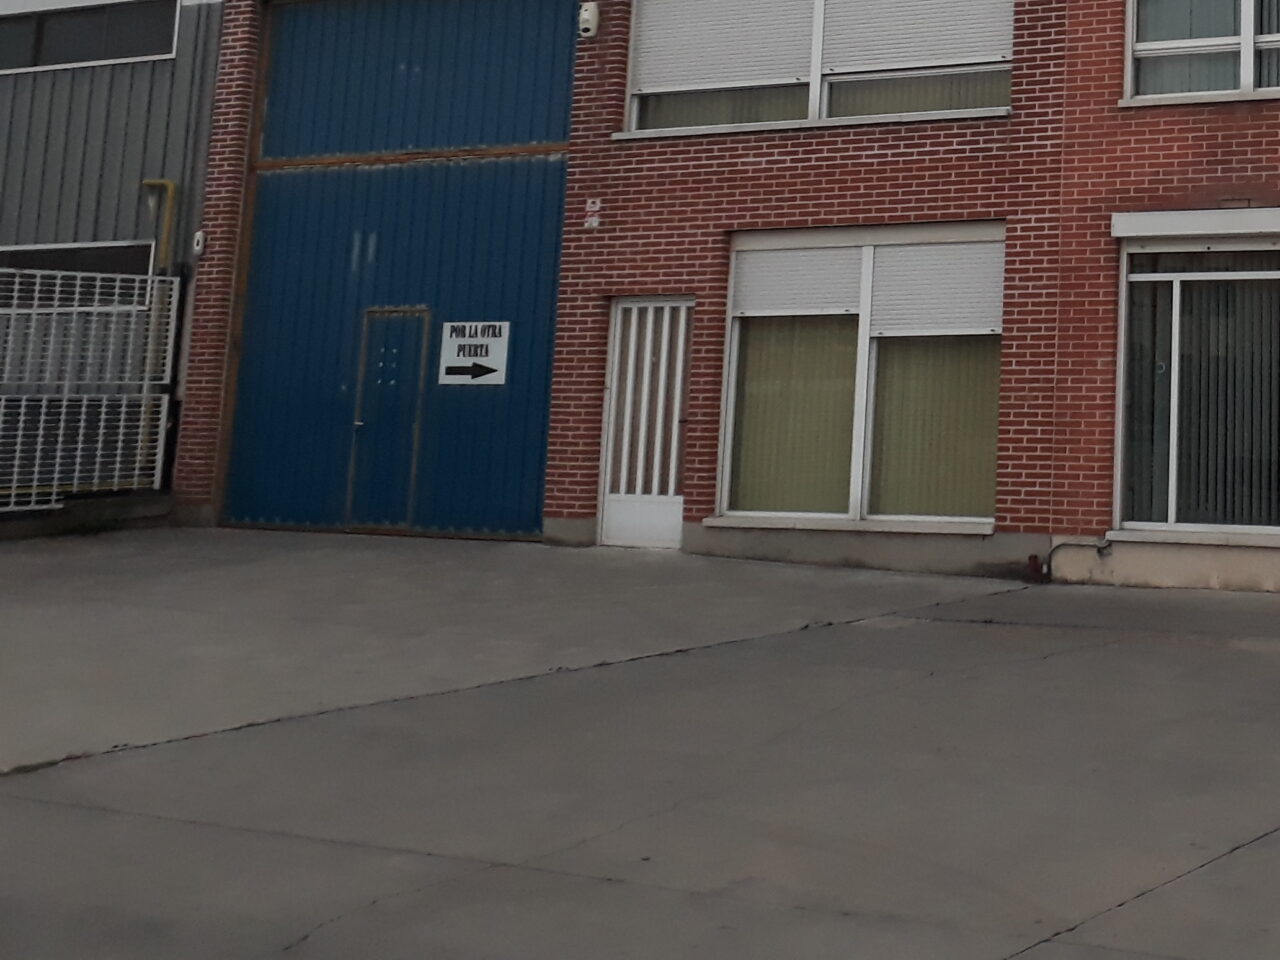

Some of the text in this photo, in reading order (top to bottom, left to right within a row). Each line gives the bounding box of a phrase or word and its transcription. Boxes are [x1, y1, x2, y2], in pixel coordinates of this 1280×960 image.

[449, 324, 502, 339] POR LA OTRA
[457, 344, 489, 357] PUERTA
